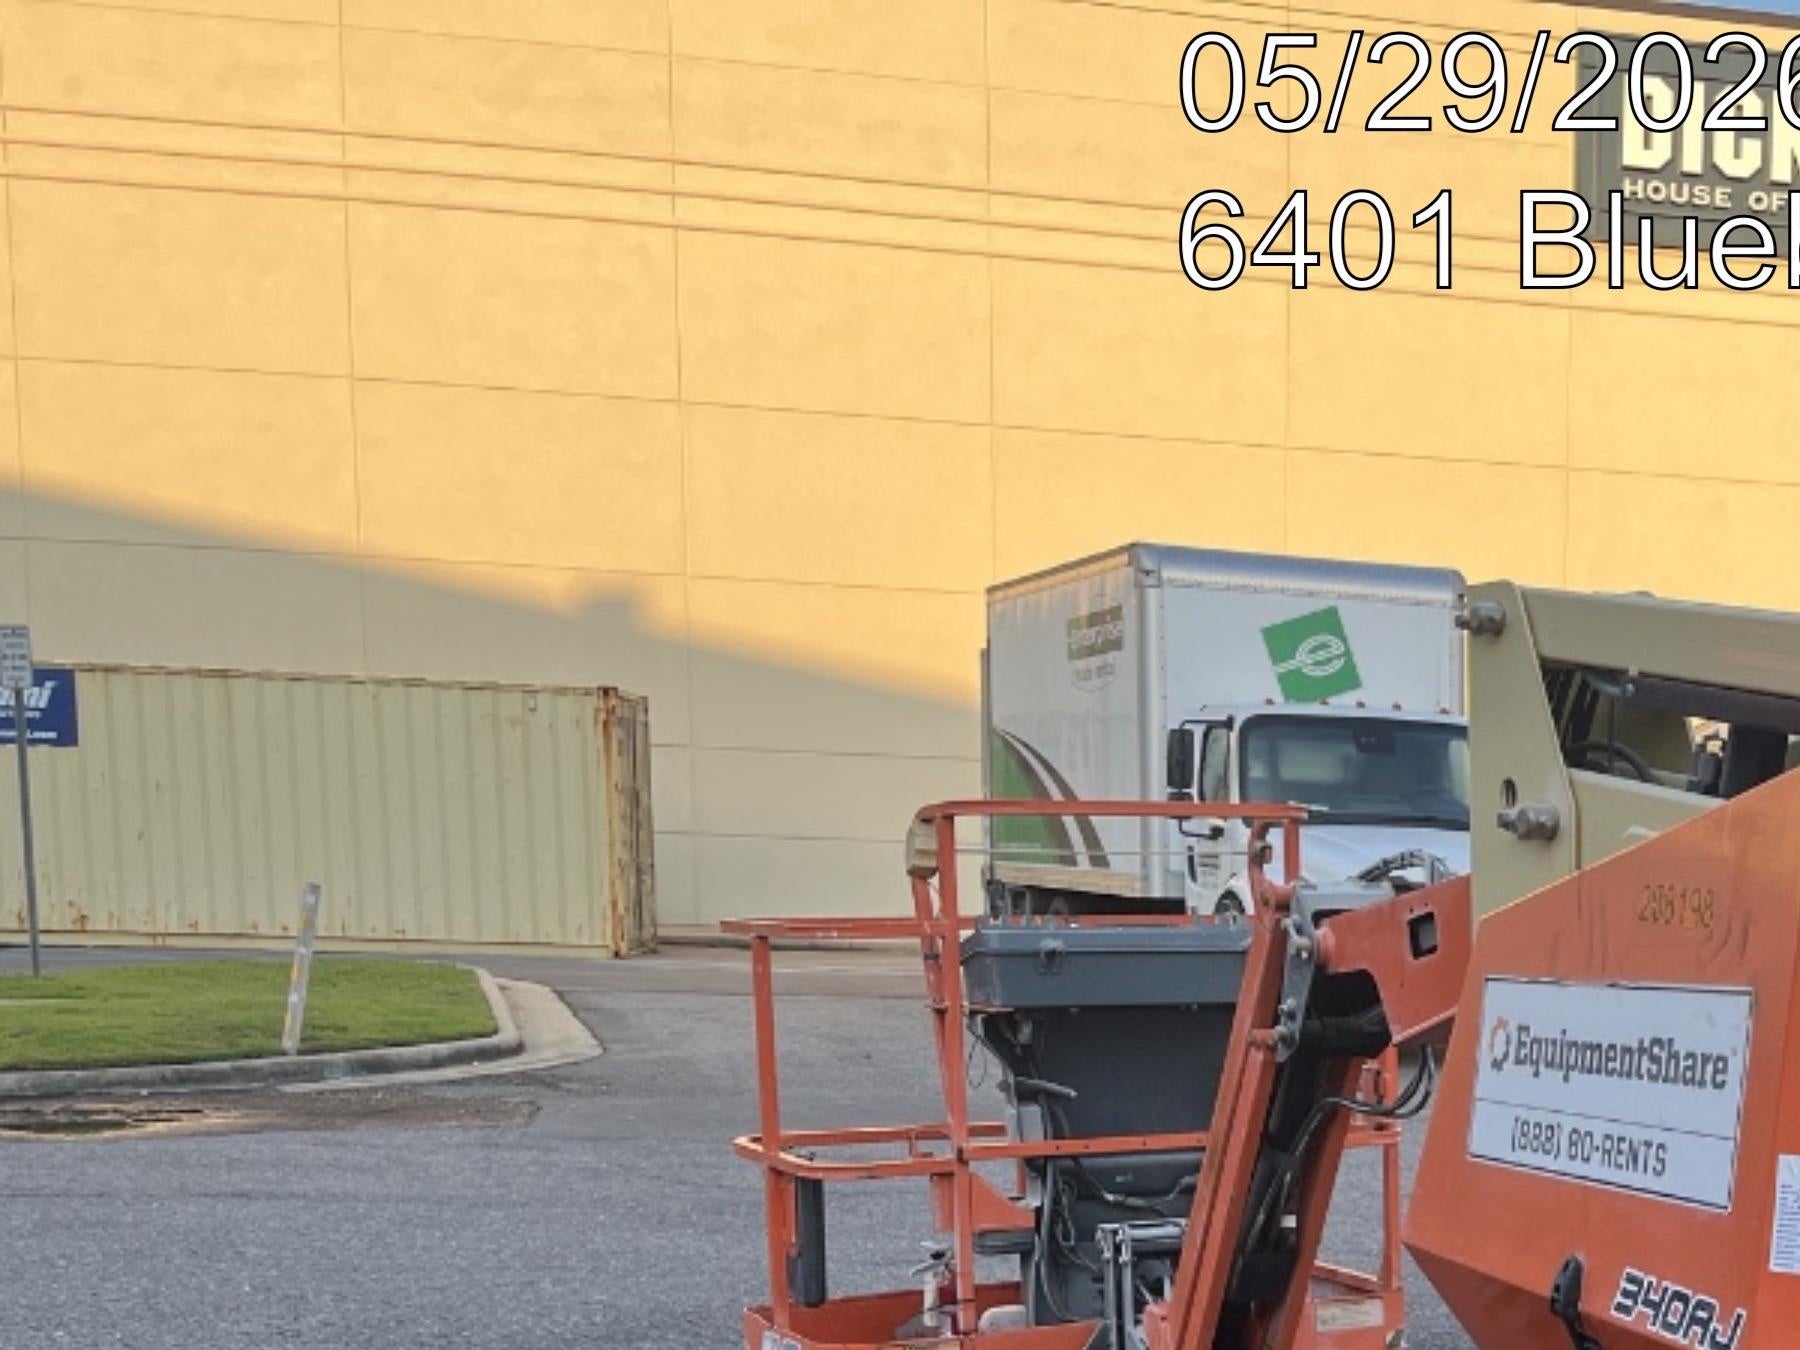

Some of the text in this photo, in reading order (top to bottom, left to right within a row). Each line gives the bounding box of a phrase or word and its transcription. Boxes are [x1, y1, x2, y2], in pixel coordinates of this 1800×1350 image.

[1622, 176, 1733, 209] HOUSE
[1748, 190, 1789, 214] OF
[1512, 1023, 1729, 1091] EquipmentShare
[1510, 1115, 1669, 1178] (888) 80-RENTS
